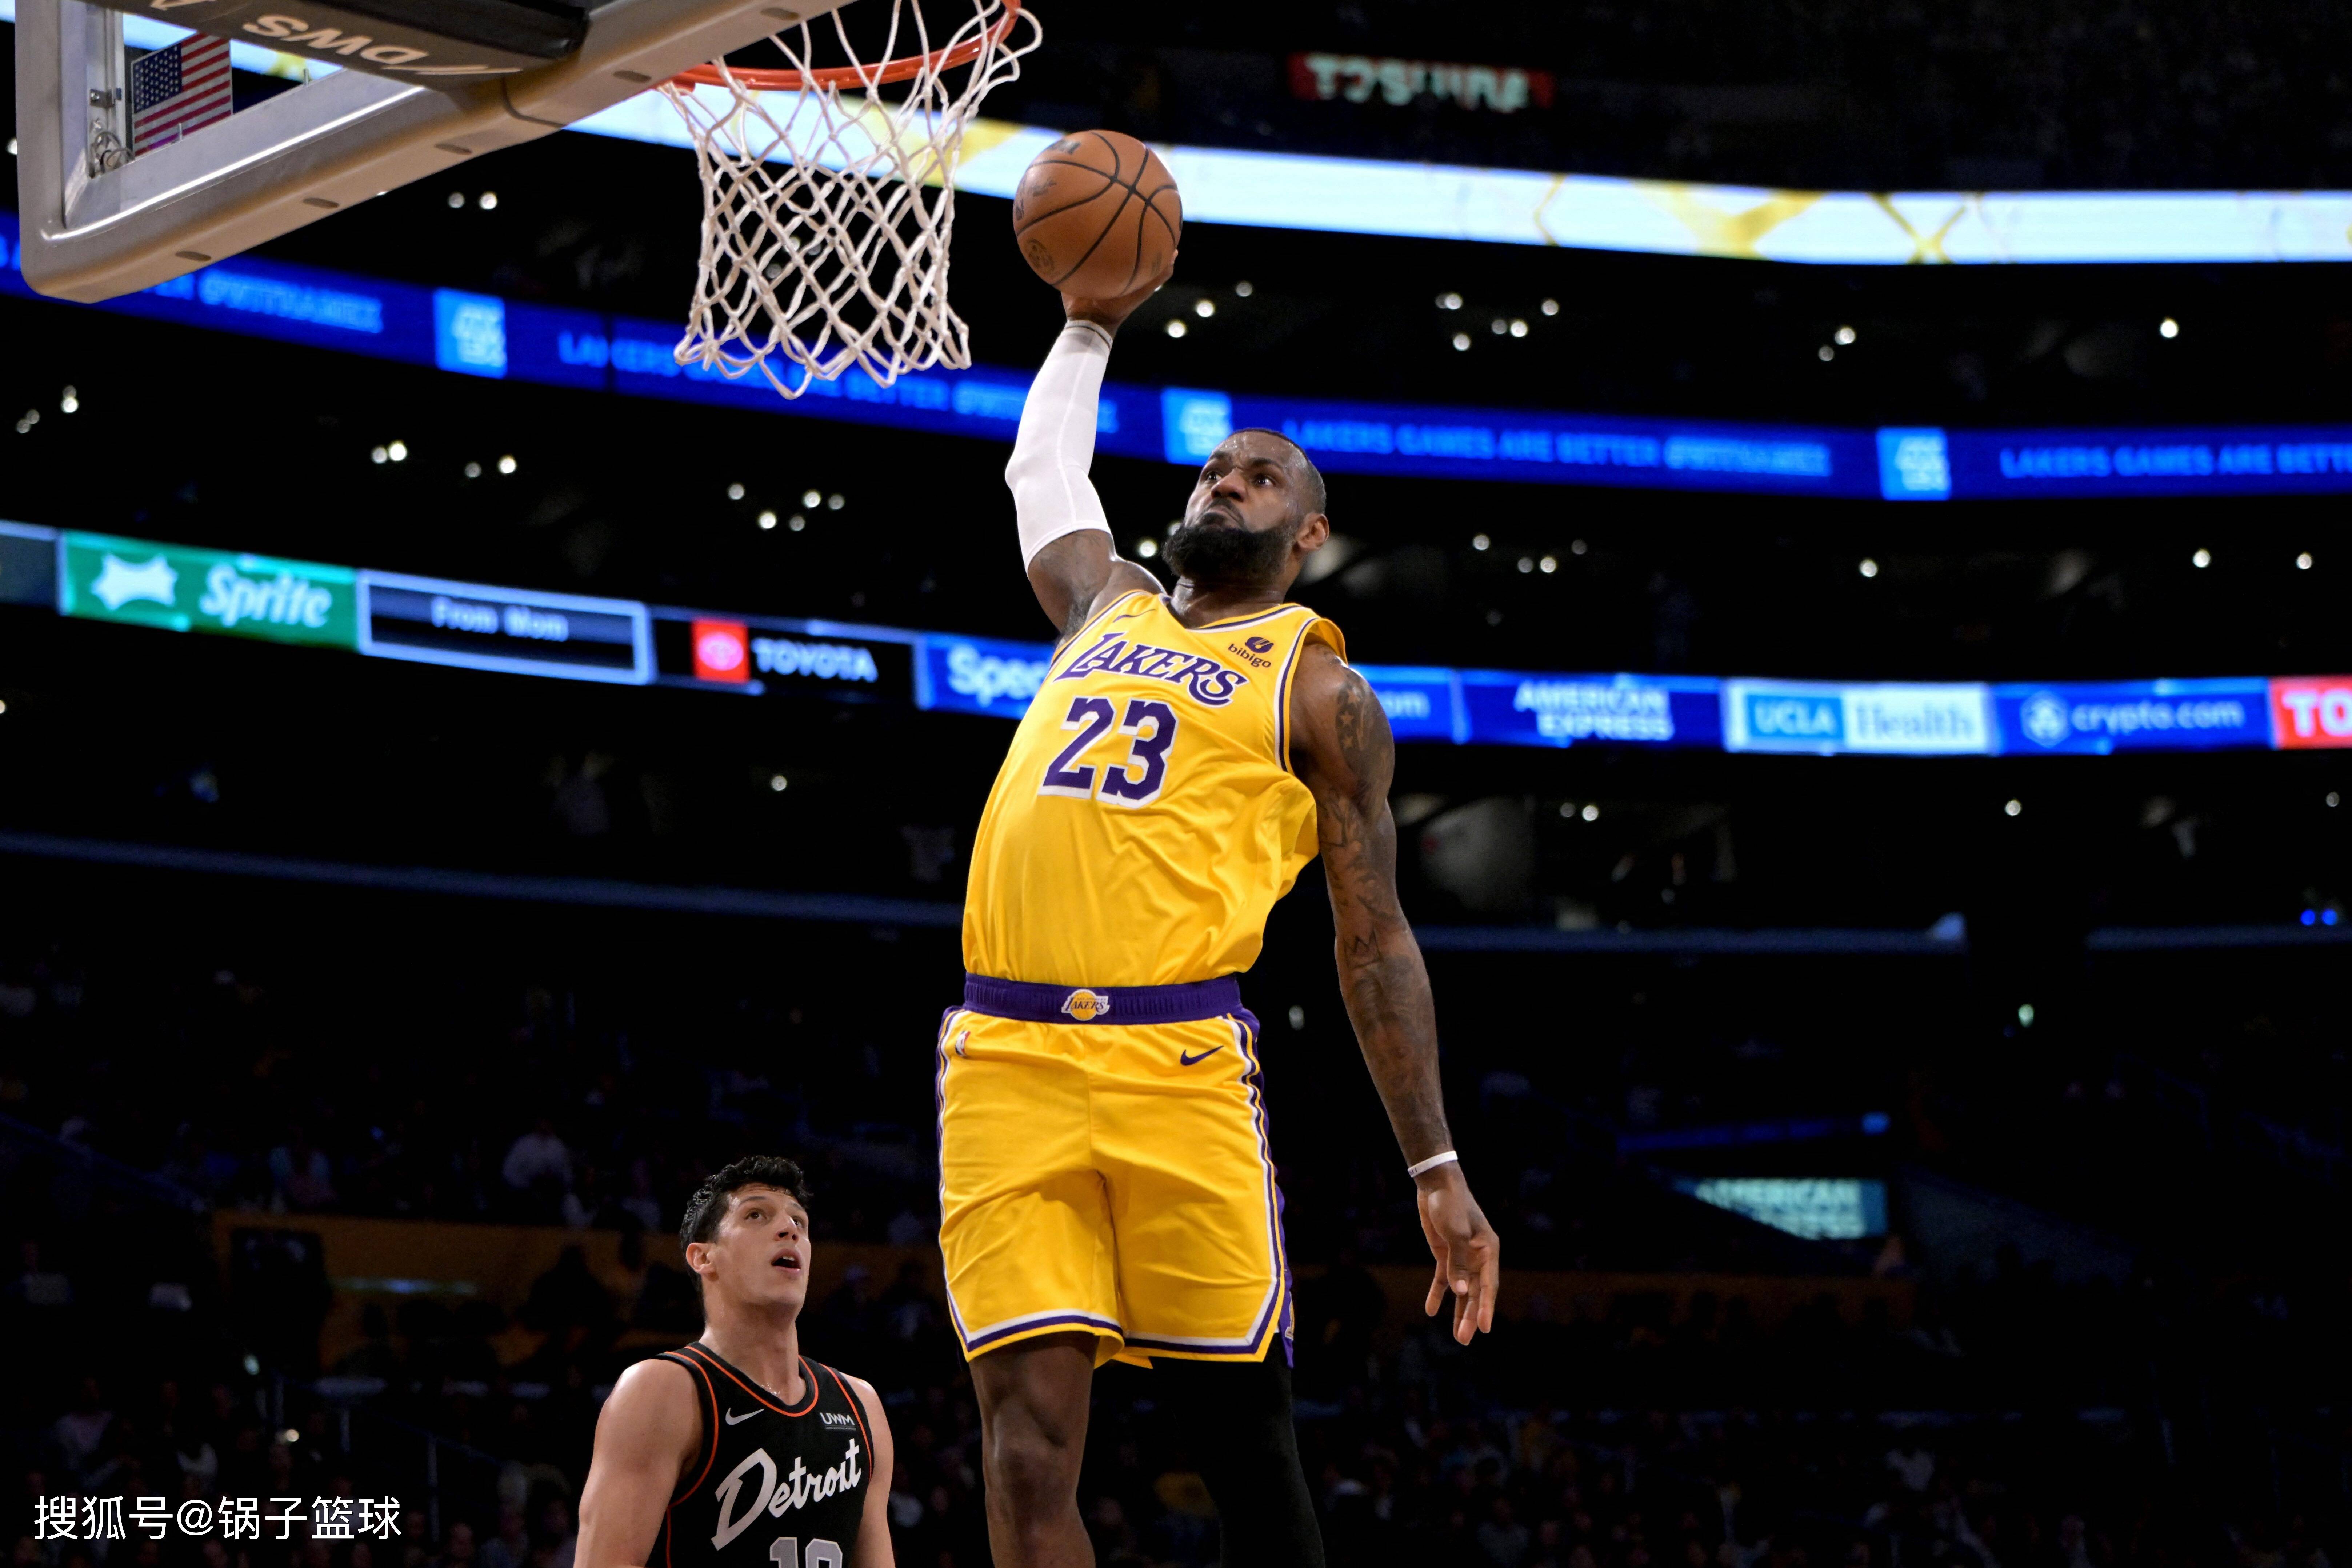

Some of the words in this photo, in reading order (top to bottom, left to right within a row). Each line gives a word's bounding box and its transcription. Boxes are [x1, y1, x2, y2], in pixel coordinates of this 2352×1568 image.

[199, 563, 332, 628] Sprite
[752, 637, 879, 683] TOYOTA
[1054, 632, 1249, 708] LAKERS
[1228, 643, 1272, 669] bibigo
[1514, 680, 1670, 714] AMERICAN
[1537, 713, 1675, 741] EXPRESS
[1753, 701, 1837, 736] UCLA
[1855, 700, 1973, 740] Health
[2071, 699, 2245, 735] crypto.com
[1038, 696, 1179, 809] 23
[1065, 997, 1106, 1013] LAKERS
[819, 1412, 855, 1426] UWM
[711, 1438, 862, 1551] Detroit
